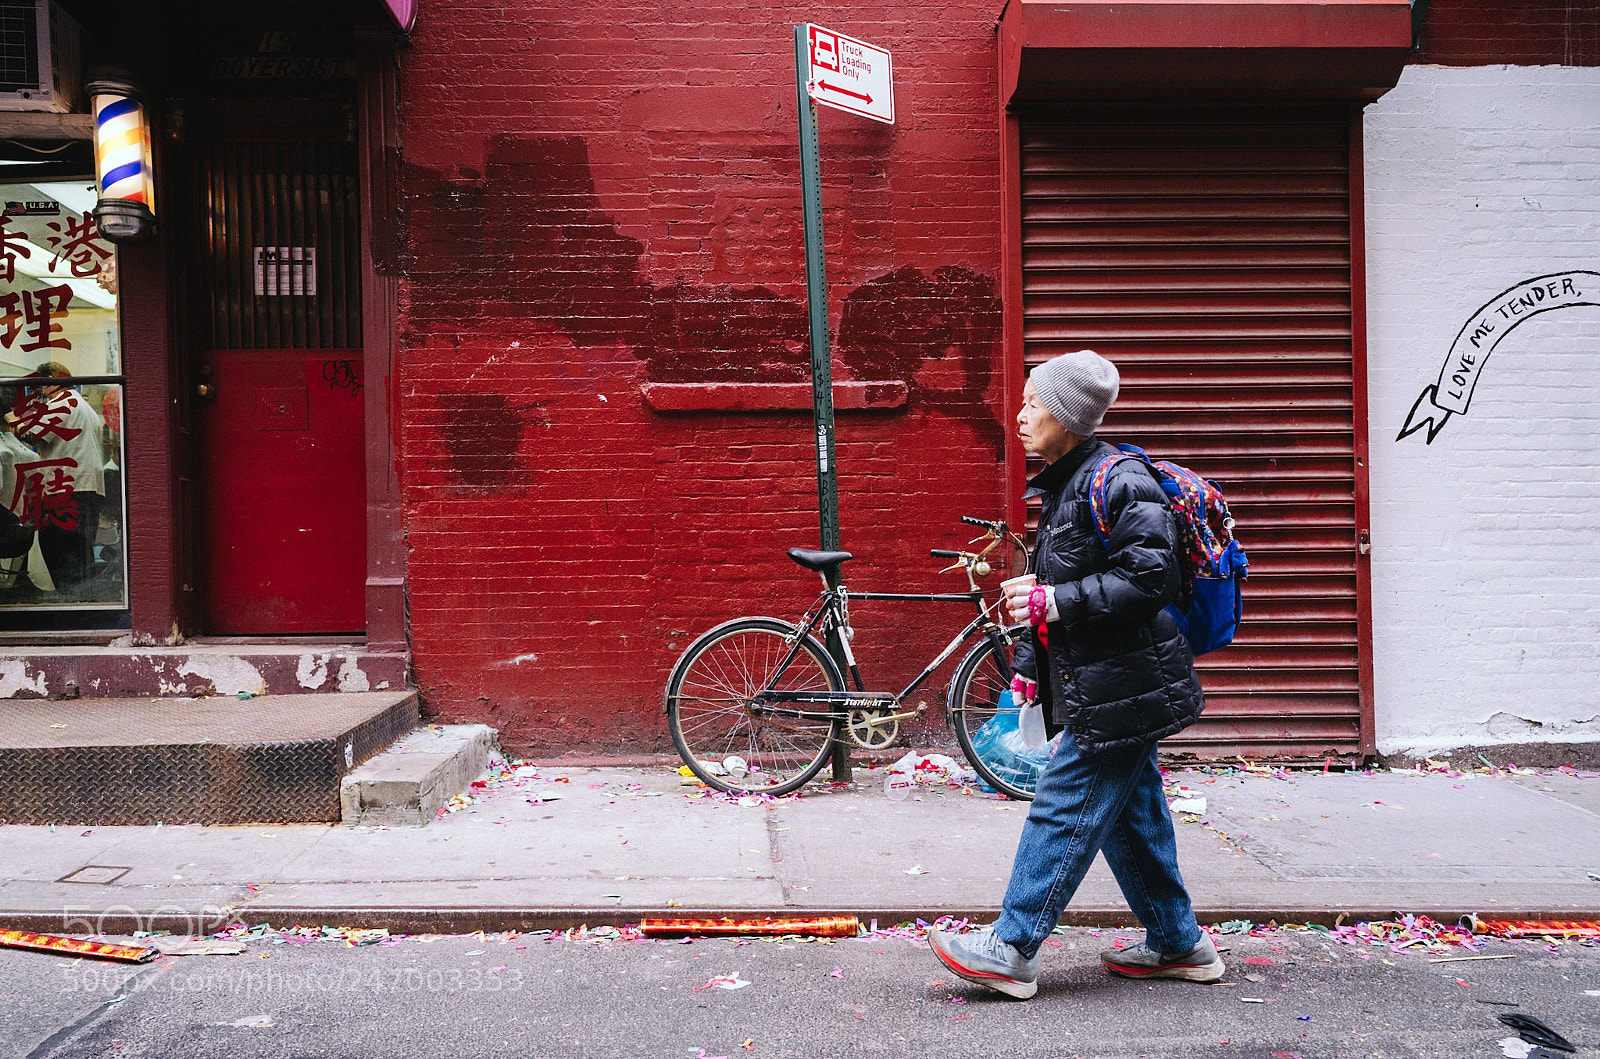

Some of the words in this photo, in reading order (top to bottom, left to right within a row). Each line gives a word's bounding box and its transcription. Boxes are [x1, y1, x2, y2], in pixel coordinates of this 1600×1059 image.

[841, 41, 863, 58] Truck
[842, 53, 872, 74] Loading
[842, 65, 860, 81] Only
[1447, 351, 1475, 400] LOVE
[1469, 318, 1496, 349] ME
[1494, 278, 1582, 319] TENDER,
[843, 697, 884, 708] Starlight
